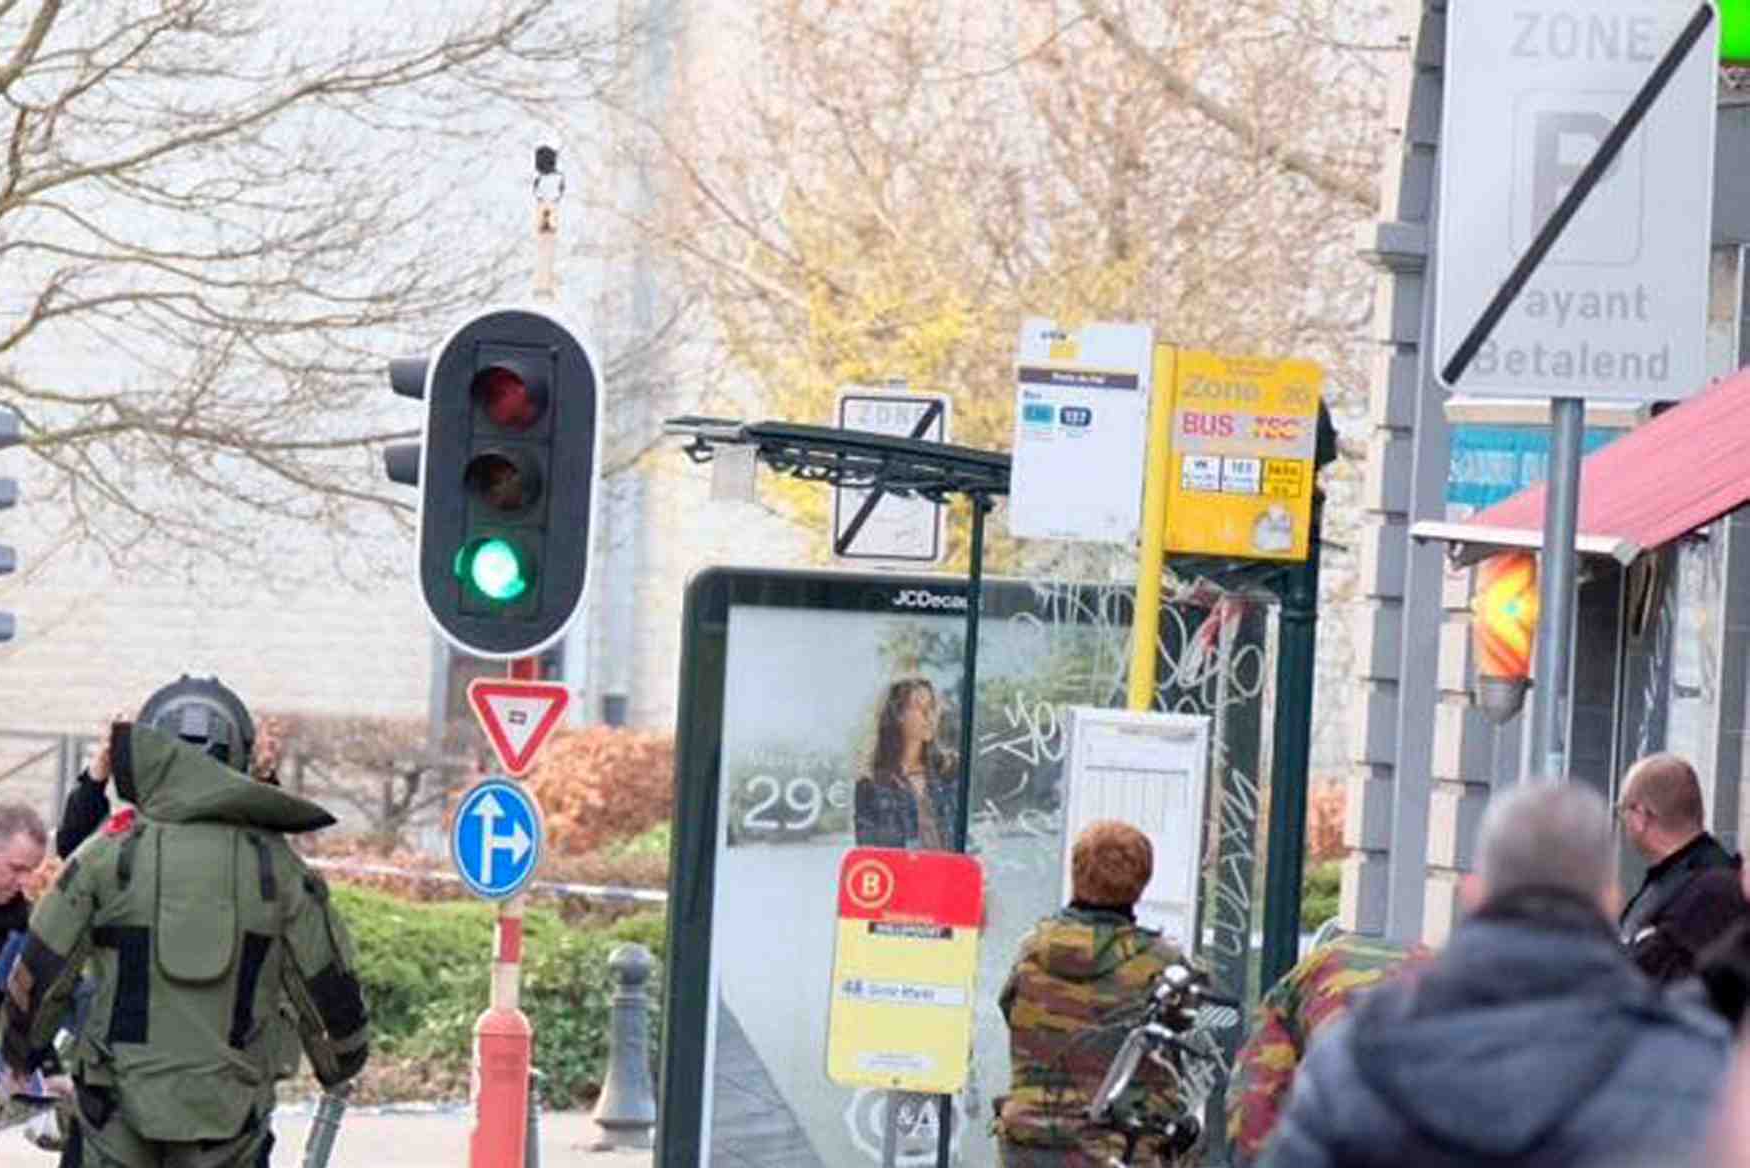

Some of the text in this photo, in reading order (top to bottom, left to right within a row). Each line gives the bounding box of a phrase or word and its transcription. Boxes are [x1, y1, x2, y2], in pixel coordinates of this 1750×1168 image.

[1510, 12, 1657, 61] ZONE
[1522, 283, 1650, 326] ayant
[1472, 338, 1671, 384] Betalend
[1181, 375, 1260, 398] Zone
[1183, 411, 1234, 438] BUS
[743, 775, 852, 830] 29€
[861, 872, 881, 897] B
